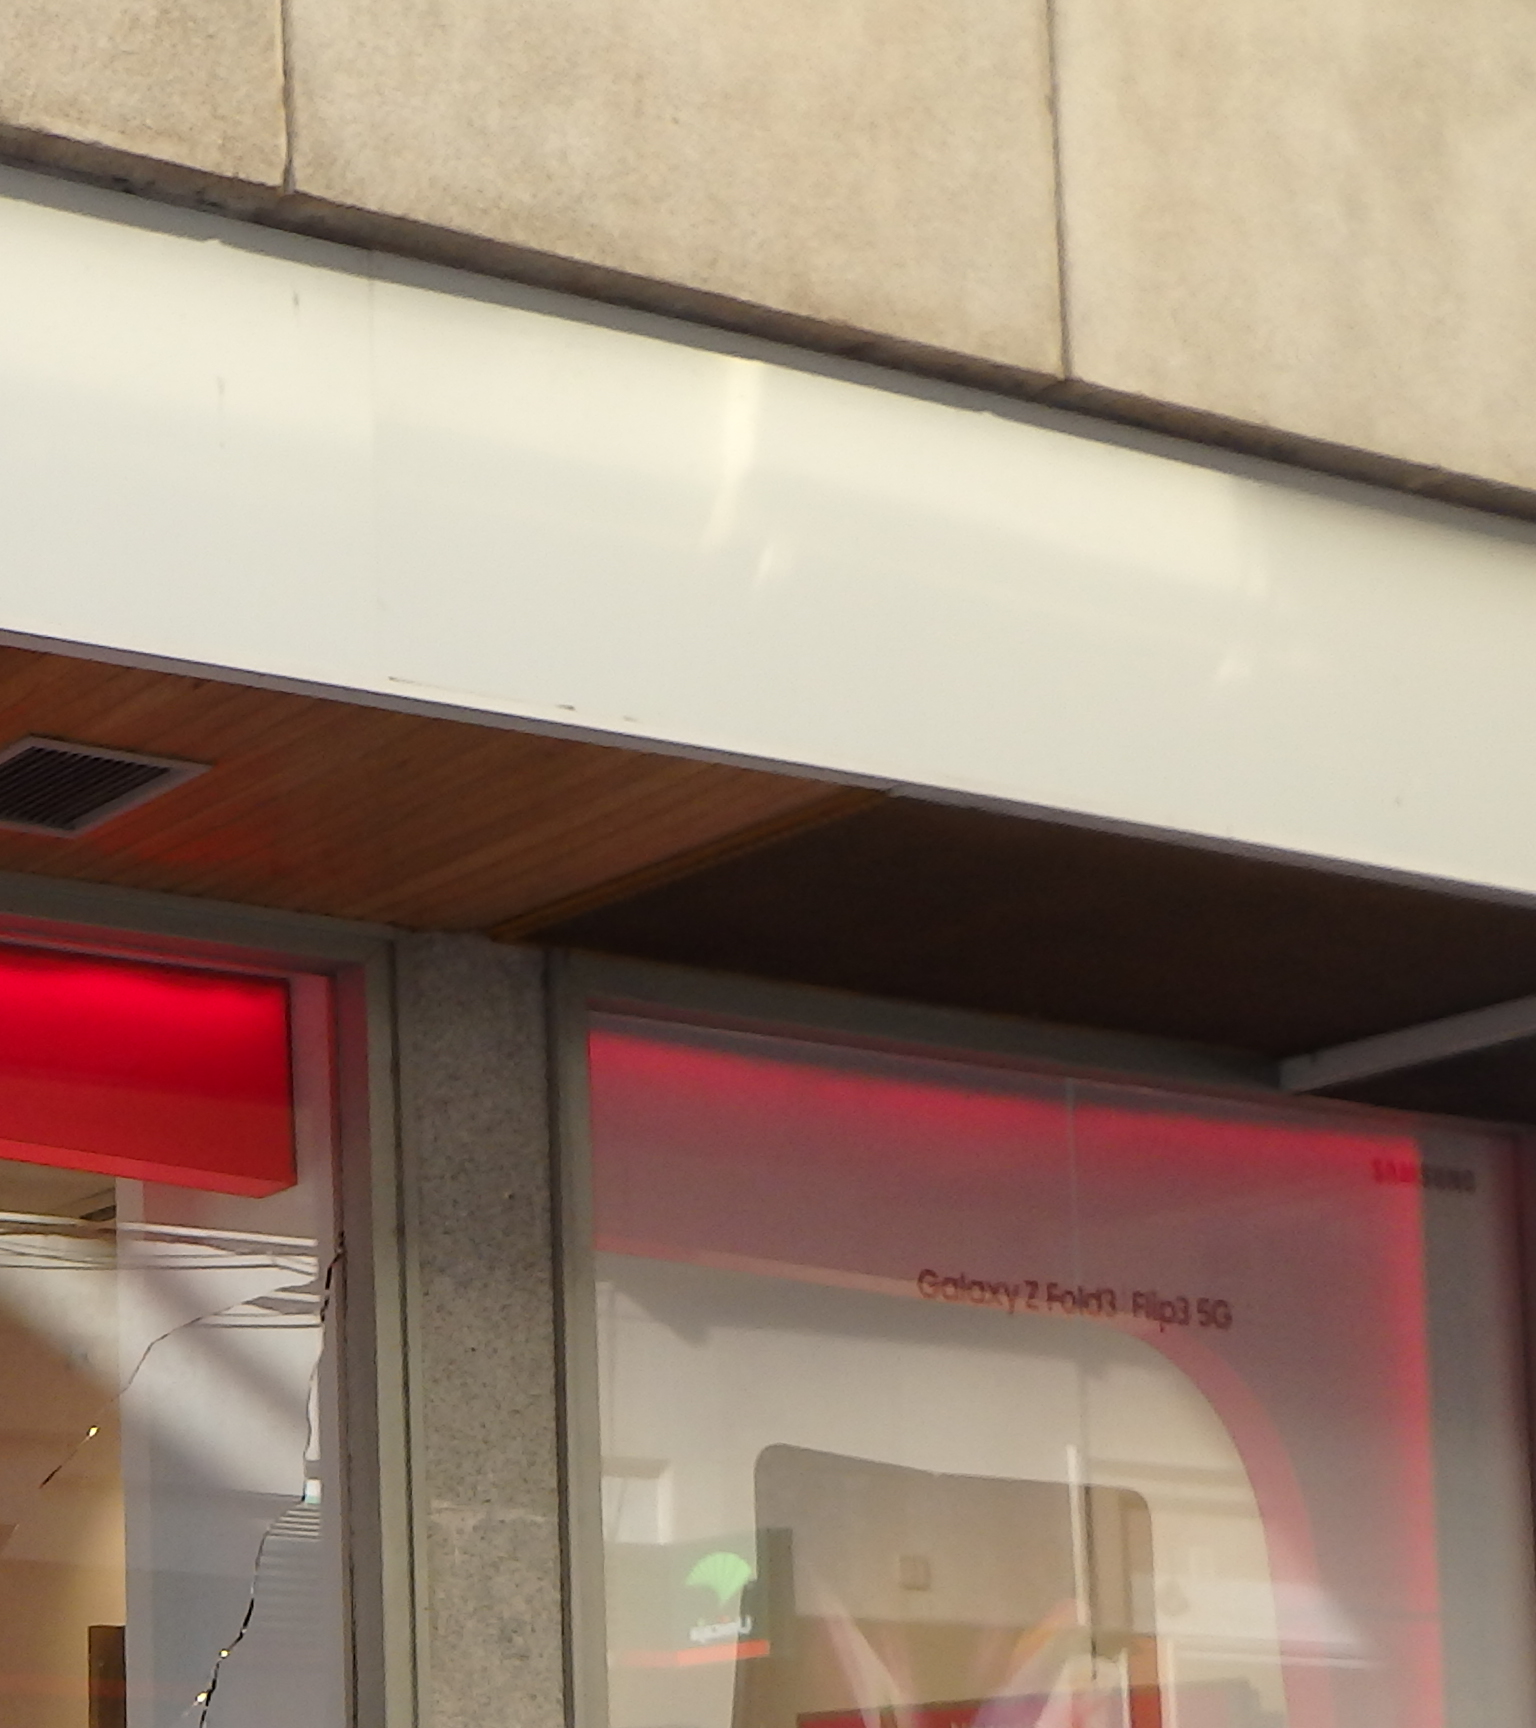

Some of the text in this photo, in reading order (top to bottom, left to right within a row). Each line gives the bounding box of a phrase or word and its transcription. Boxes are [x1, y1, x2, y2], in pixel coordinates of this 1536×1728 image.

[917, 1268, 1019, 1315] Galaxy
[1024, 1280, 1040, 1311] Z
[1046, 1281, 1117, 1317] Fold3
[1196, 1297, 1233, 1330] 5G
